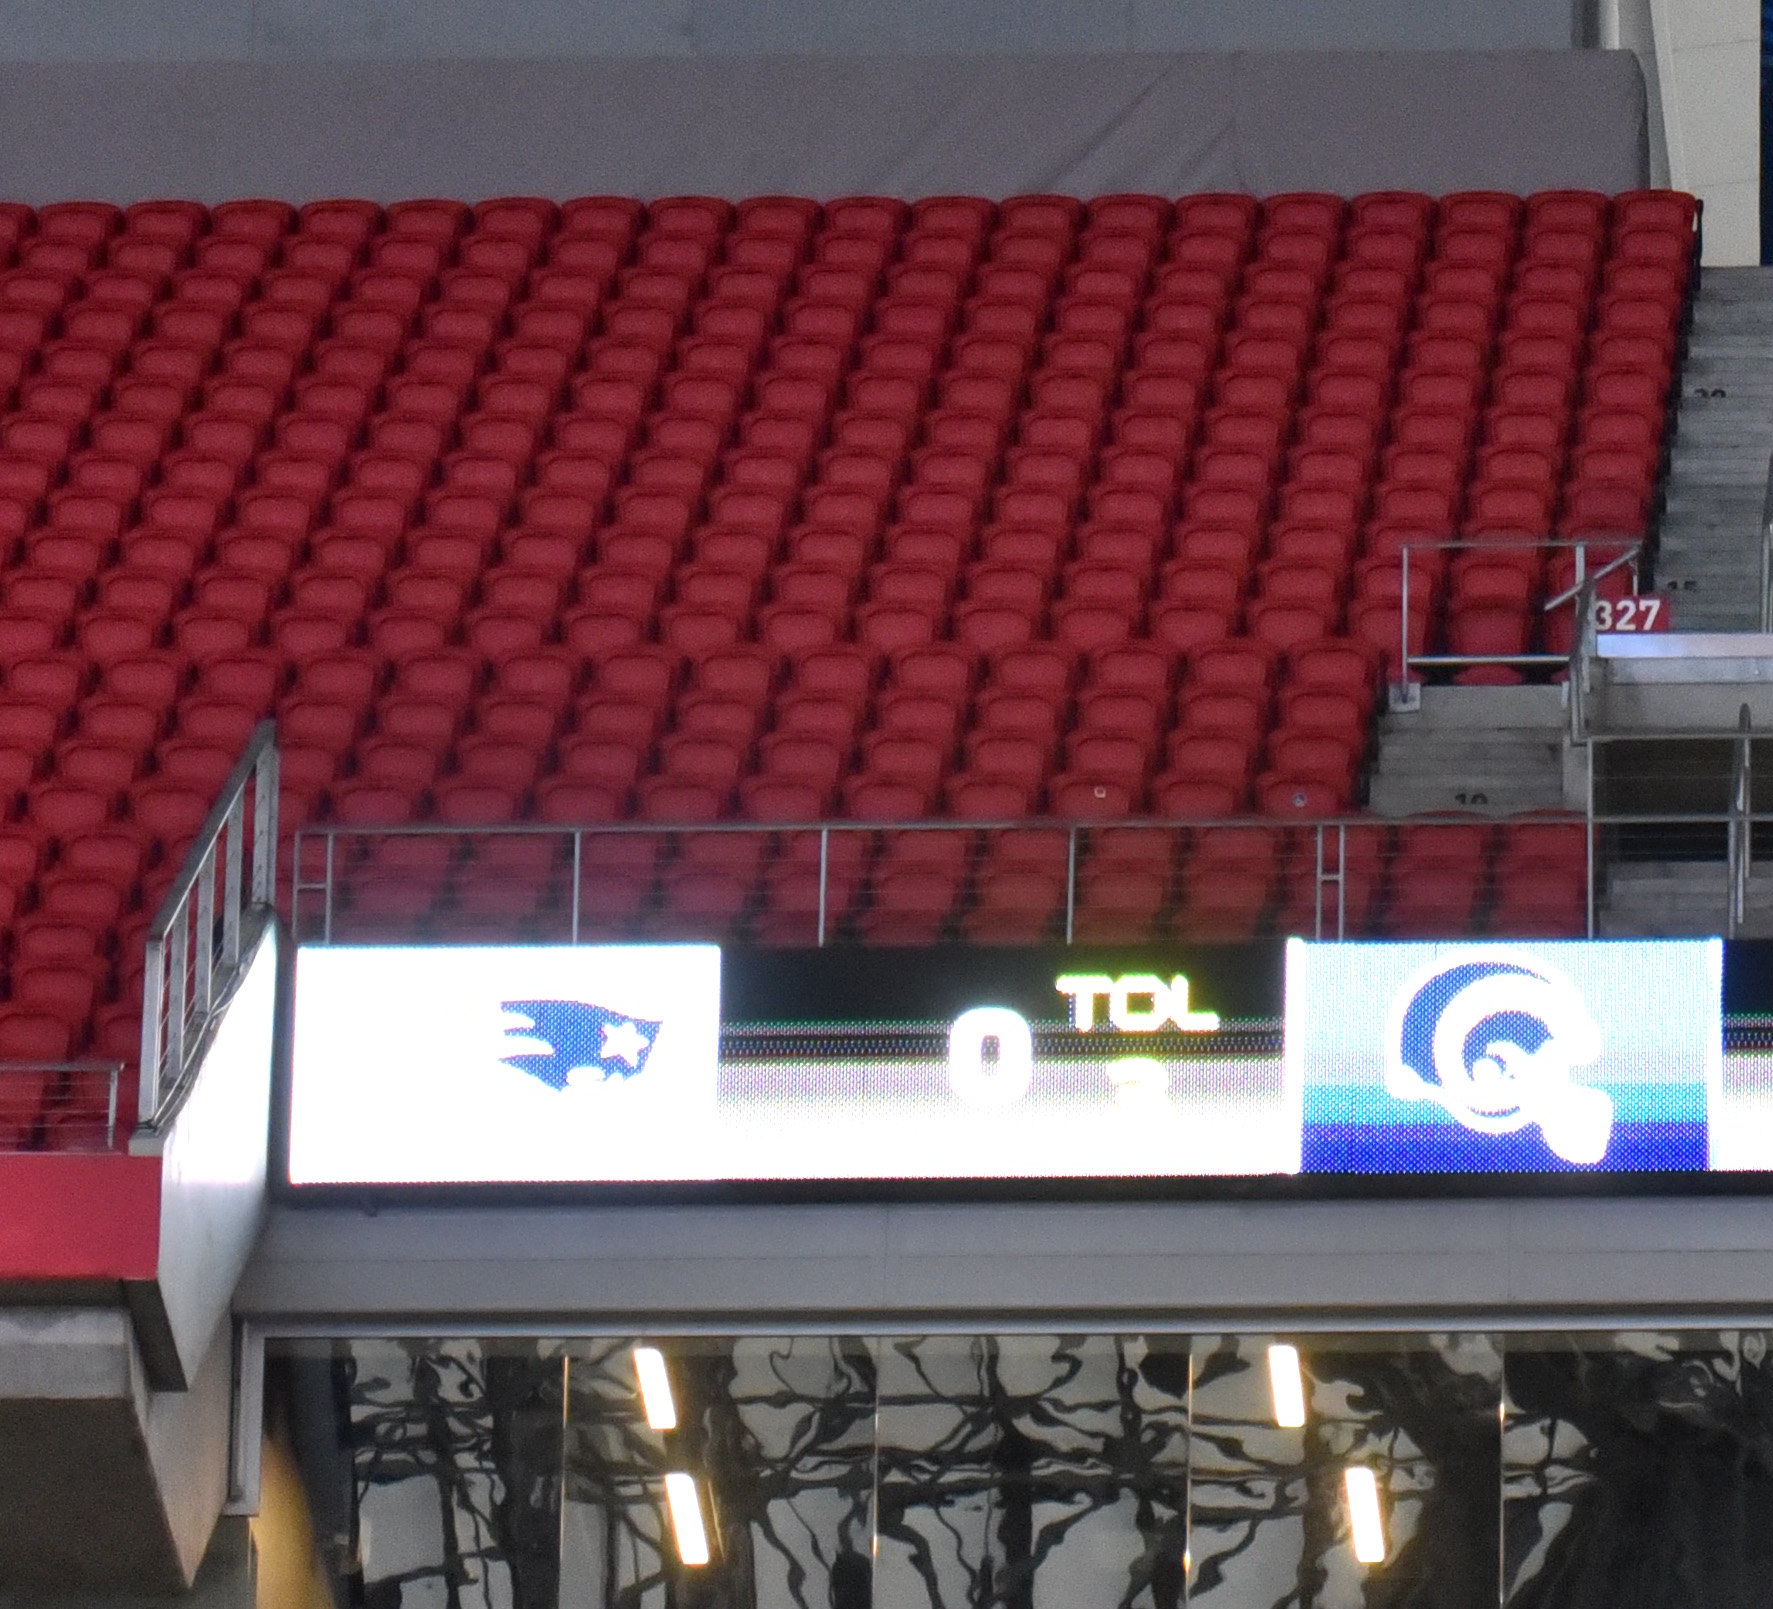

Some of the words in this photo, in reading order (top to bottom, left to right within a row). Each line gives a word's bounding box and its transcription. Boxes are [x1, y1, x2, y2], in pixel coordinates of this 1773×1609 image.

[1596, 599, 1661, 631] 327
[1057, 974, 1220, 1032] TOL
[948, 1006, 1034, 1109] 0
